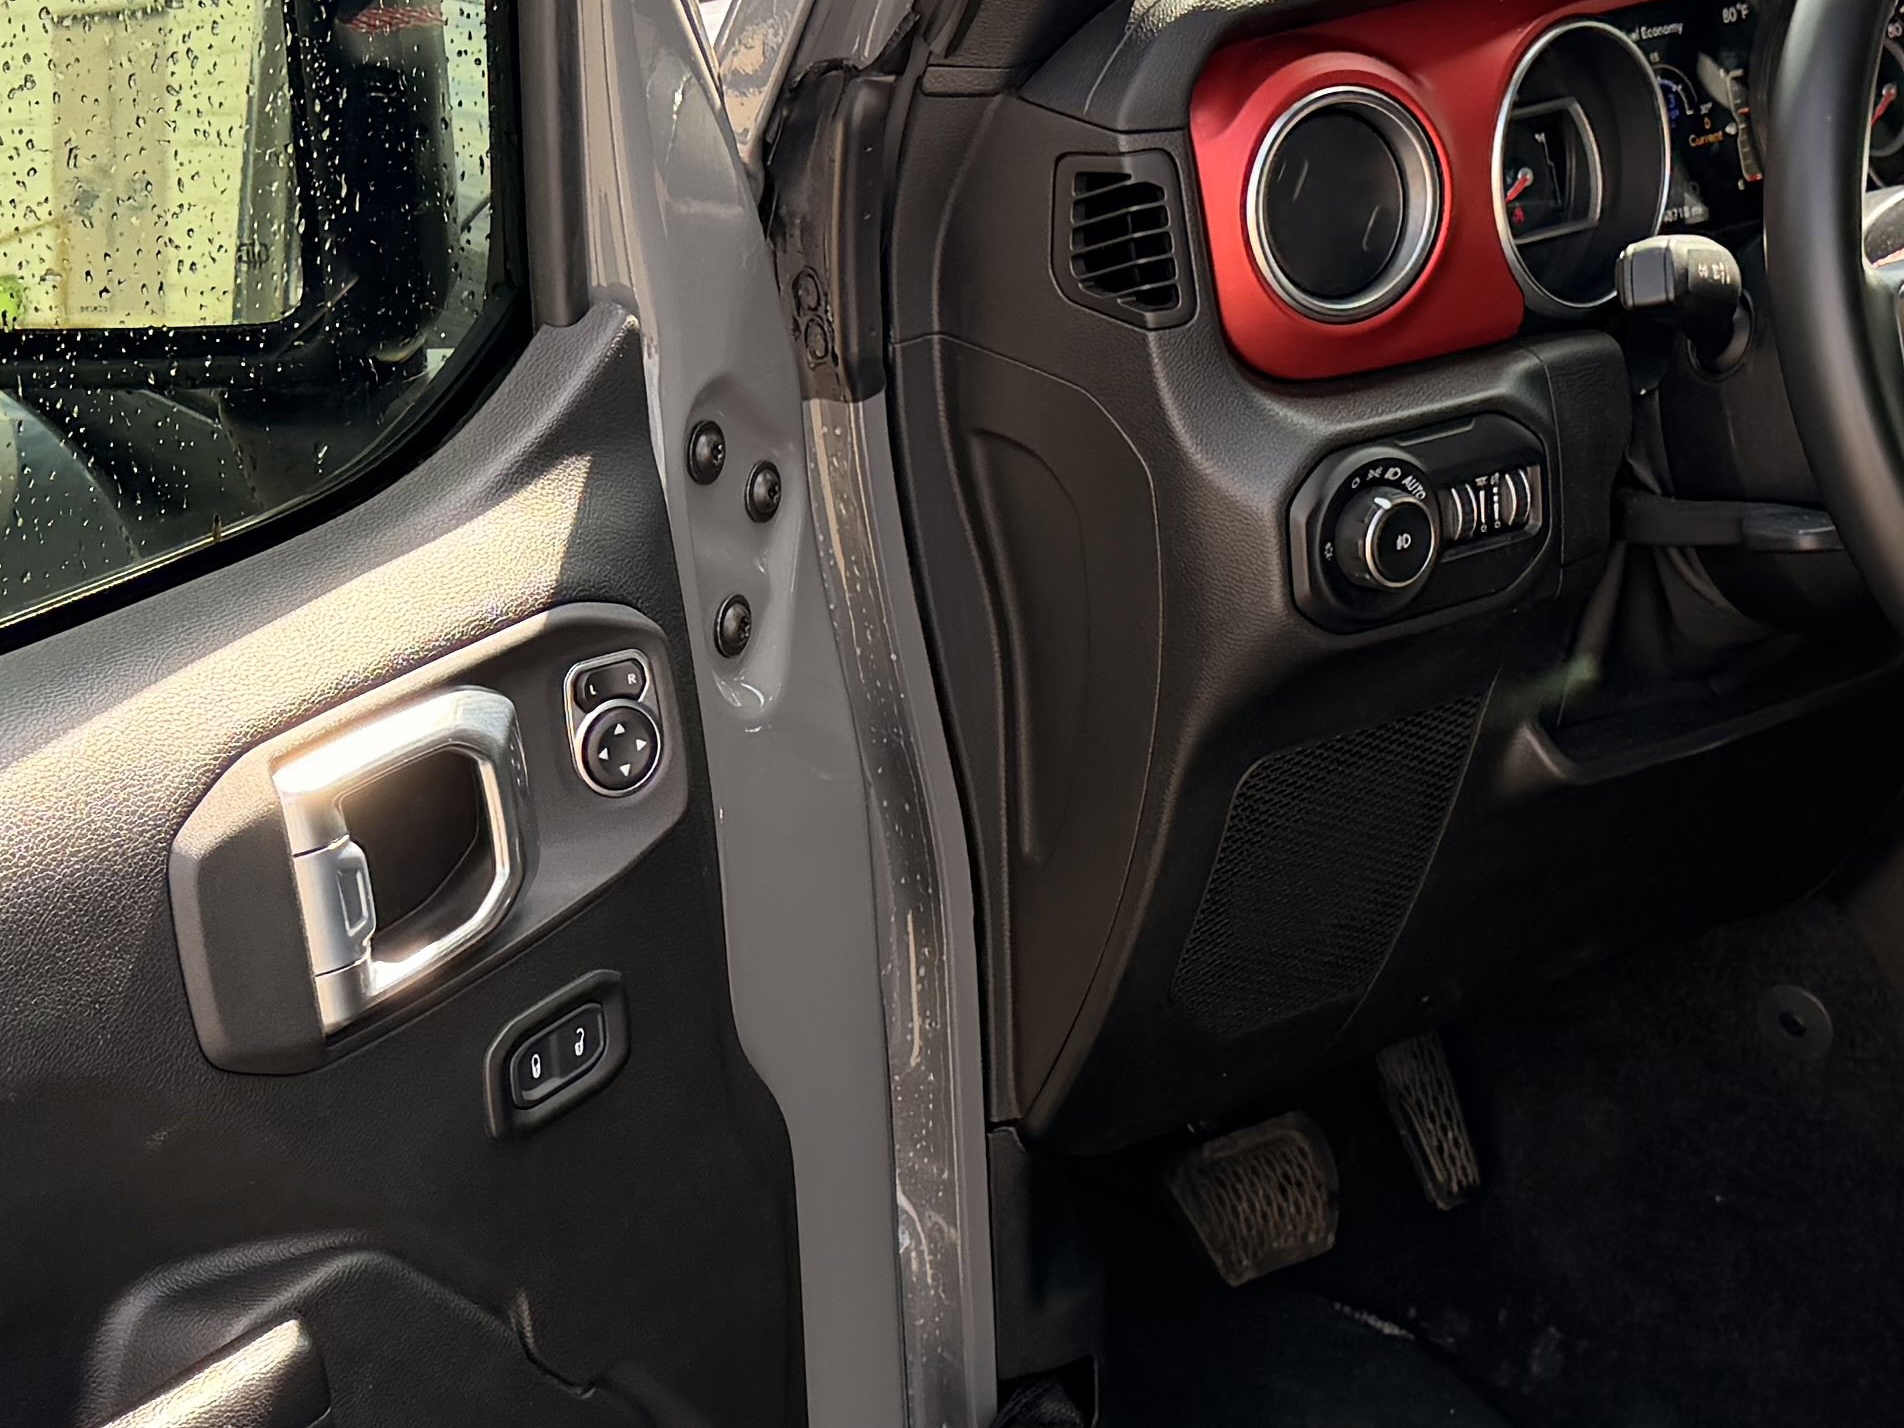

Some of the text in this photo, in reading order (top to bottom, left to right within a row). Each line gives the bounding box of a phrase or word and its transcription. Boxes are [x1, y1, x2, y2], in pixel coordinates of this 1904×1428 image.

[1640, 21, 1684, 40] Economy
[1688, 129, 1724, 148] Current
[1401, 474, 1427, 501] AUTO
[589, 672, 637, 696] L R
